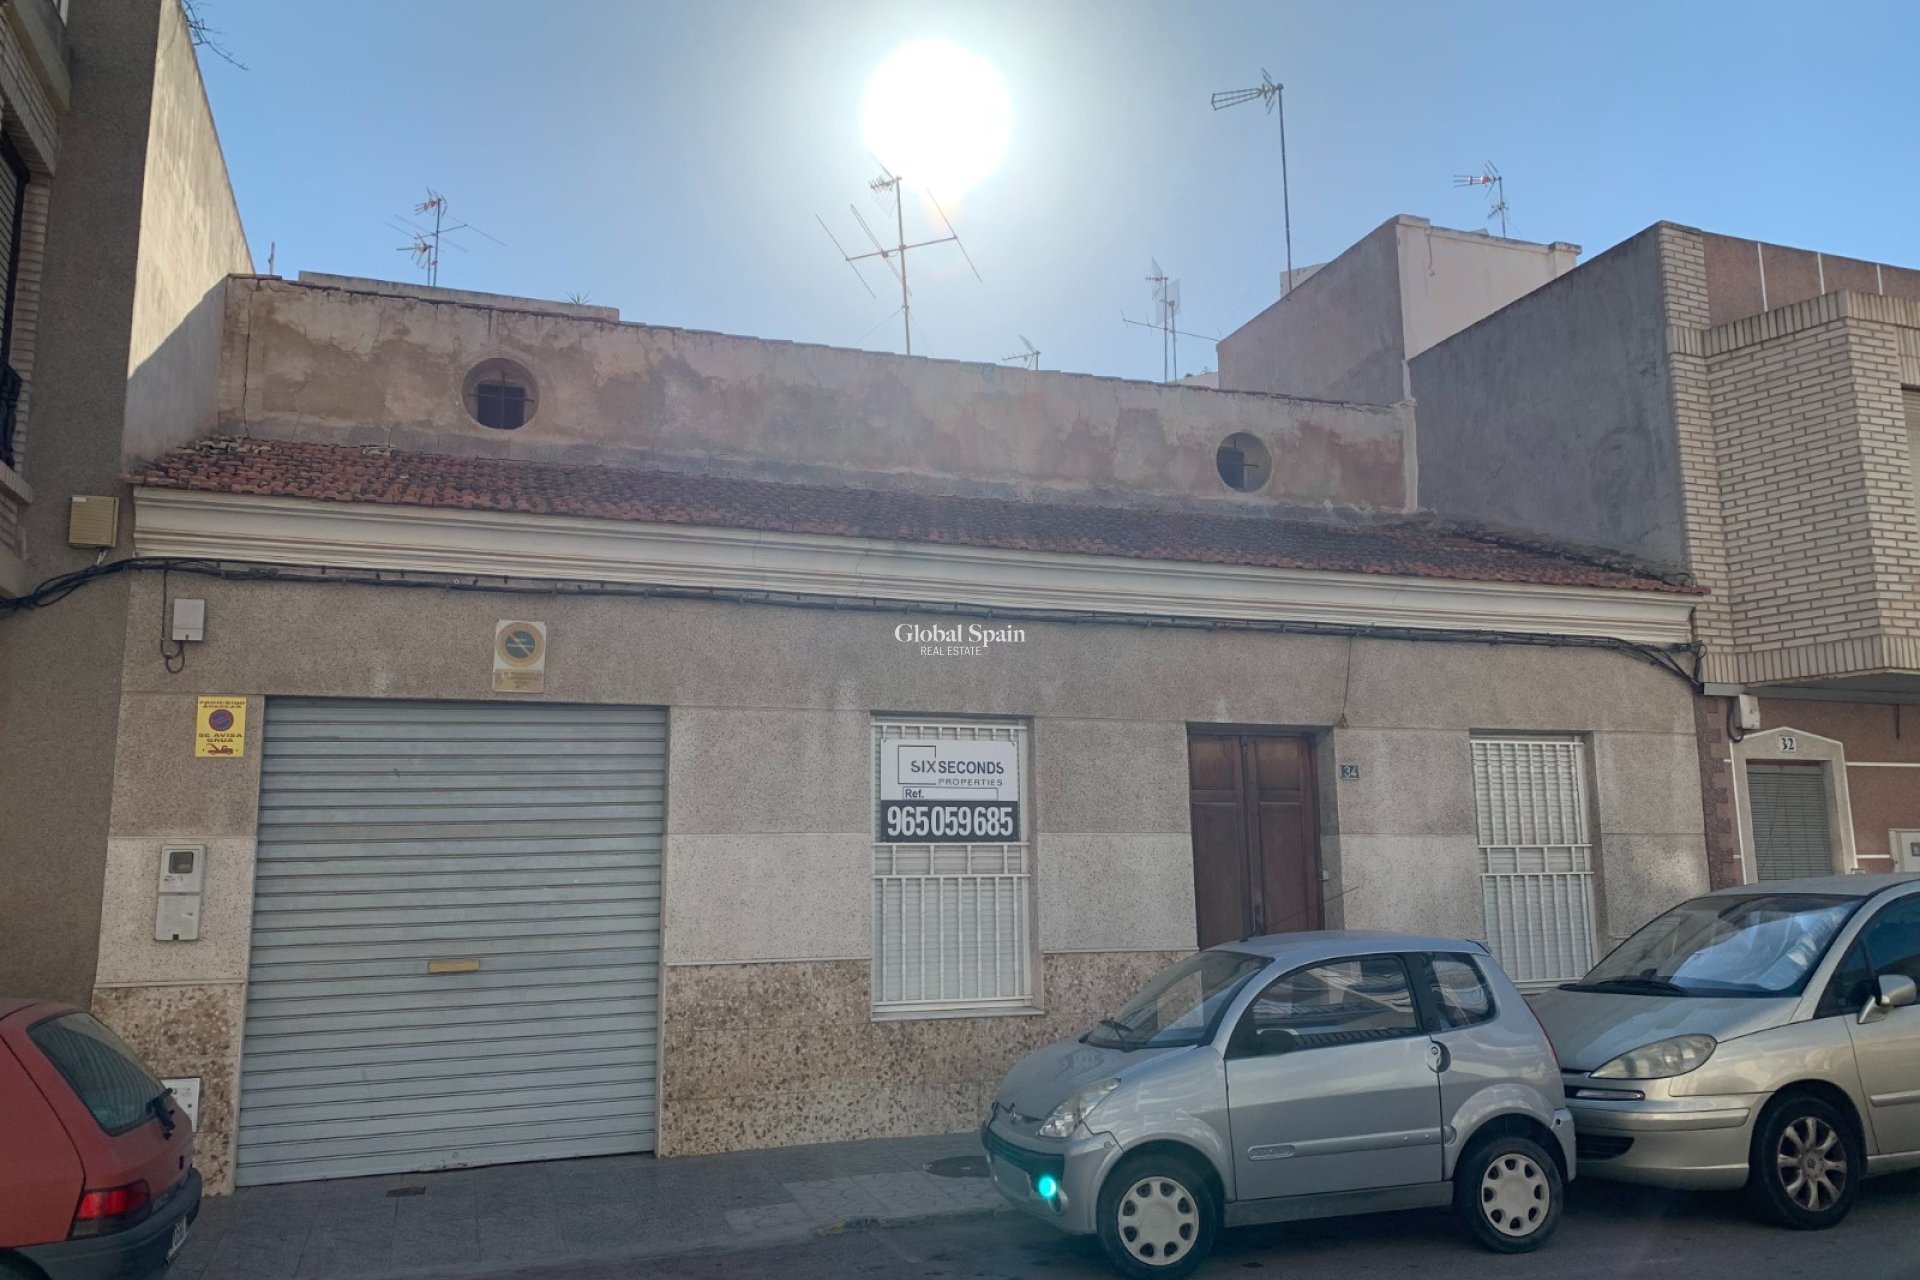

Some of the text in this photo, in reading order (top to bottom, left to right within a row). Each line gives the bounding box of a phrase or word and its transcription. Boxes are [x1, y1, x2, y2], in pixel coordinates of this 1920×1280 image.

[1781, 737, 1795, 750] 32
[1343, 765, 1357, 778] 34
[937, 778, 1003, 787] PROPERTIES
[905, 788, 925, 799] Ref.
